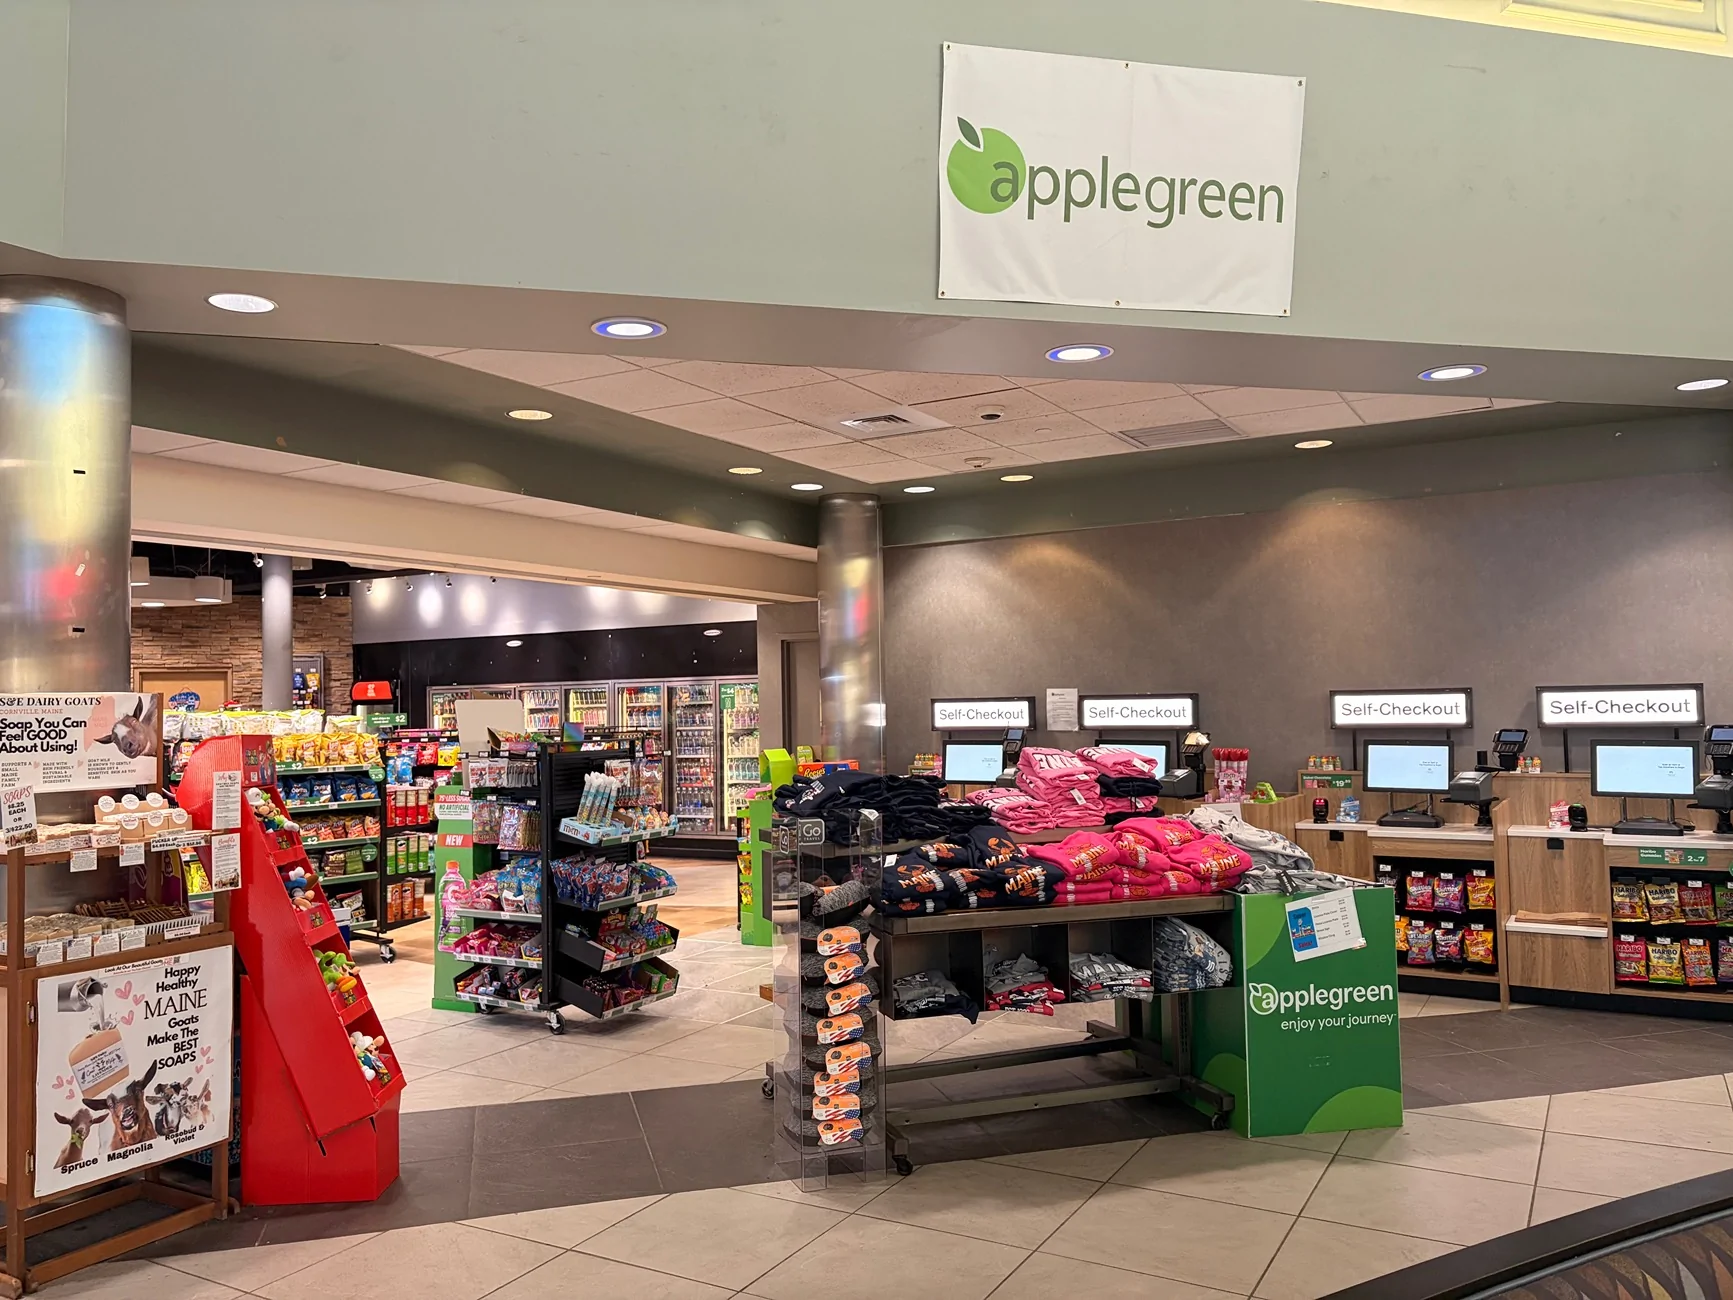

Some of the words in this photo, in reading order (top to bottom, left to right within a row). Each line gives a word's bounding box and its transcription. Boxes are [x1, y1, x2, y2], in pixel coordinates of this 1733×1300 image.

[990, 155, 1284, 229] applegreen
[27, 697, 62, 706] DAIRY
[65, 697, 101, 706] GOATS
[1341, 702, 1461, 717] Self-Checkout
[1550, 699, 1691, 715] Self-Checkout
[939, 708, 1024, 720] Self-Checkout
[1089, 706, 1187, 719] Self-Checkout
[0, 718, 33, 732] Soap
[35, 717, 60, 728] You
[62, 717, 87, 728] Can
[0, 730, 24, 741] Feel
[27, 729, 67, 740] GOOD
[0, 742, 38, 753] About
[40, 740, 78, 754] Using!
[3, 786, 31, 804] SOAPS
[8, 807, 26, 816] EACH
[803, 823, 821, 837] Go
[445, 835, 464, 846] NEW
[1071, 845, 1109, 869] MAINE
[1200, 853, 1241, 876] MAINE
[898, 869, 941, 889] MAINE
[1004, 866, 1048, 895] MAINE
[165, 965, 201, 978] Happy
[156, 977, 198, 993] Healthy
[144, 988, 207, 1020] MAINE
[1261, 983, 1394, 1013] applegreen
[168, 1015, 199, 1028] Goats
[1281, 1017, 1316, 1032] enjoy
[1318, 1016, 1346, 1030] your
[1346, 1013, 1394, 1028] journey
[147, 1032, 179, 1046] Make
[180, 1027, 199, 1039] The
[174, 1037, 199, 1053] BEST
[158, 1051, 196, 1069] SOAPS
[165, 1126, 197, 1141] Rosebud
[173, 1133, 195, 1145] Violet
[107, 1142, 153, 1162] Magnolia
[61, 1157, 98, 1174] Spruce
